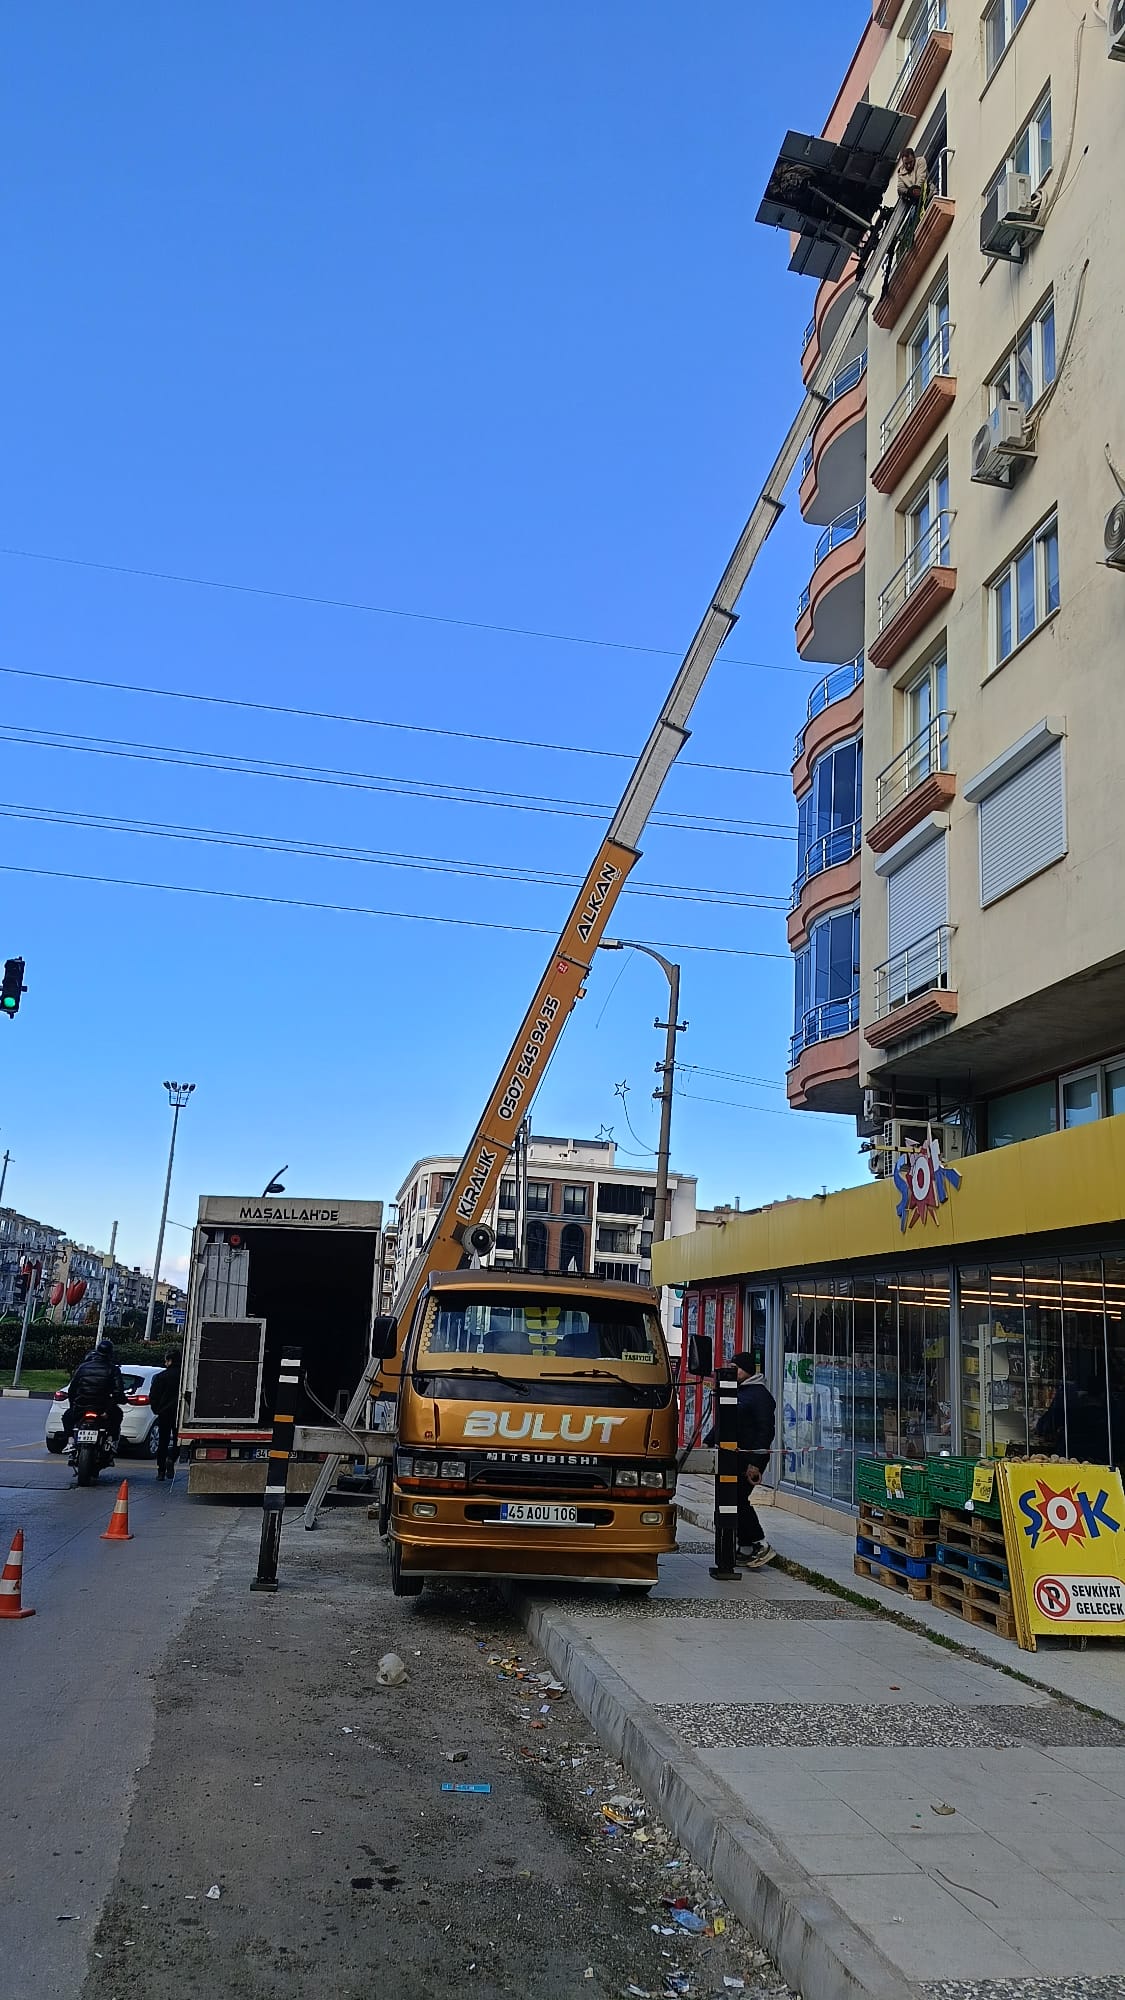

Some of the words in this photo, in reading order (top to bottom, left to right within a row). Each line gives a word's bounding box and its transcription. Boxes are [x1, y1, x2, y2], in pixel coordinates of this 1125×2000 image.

[577, 862, 617, 943] ALKAN
[540, 994, 560, 1021] 35
[531, 1019, 551, 1045] 94
[516, 1042, 540, 1079] 545
[498, 1076, 525, 1120] 0507
[456, 1146, 497, 1220] KİRALIK
[894, 1138, 963, 1233] ŞOK
[463, 1410, 628, 1444] BULUT
[486, 1452, 598, 1465] MITSUBISHI
[508, 1506, 524, 1519] 45
[526, 1506, 550, 1520] AOU
[554, 1507, 576, 1521] 106
[1018, 1488, 1121, 1550] ŞOK
[1071, 1583, 1121, 1598] SEVKİYAT
[1076, 1602, 1124, 1616] GELECEK
